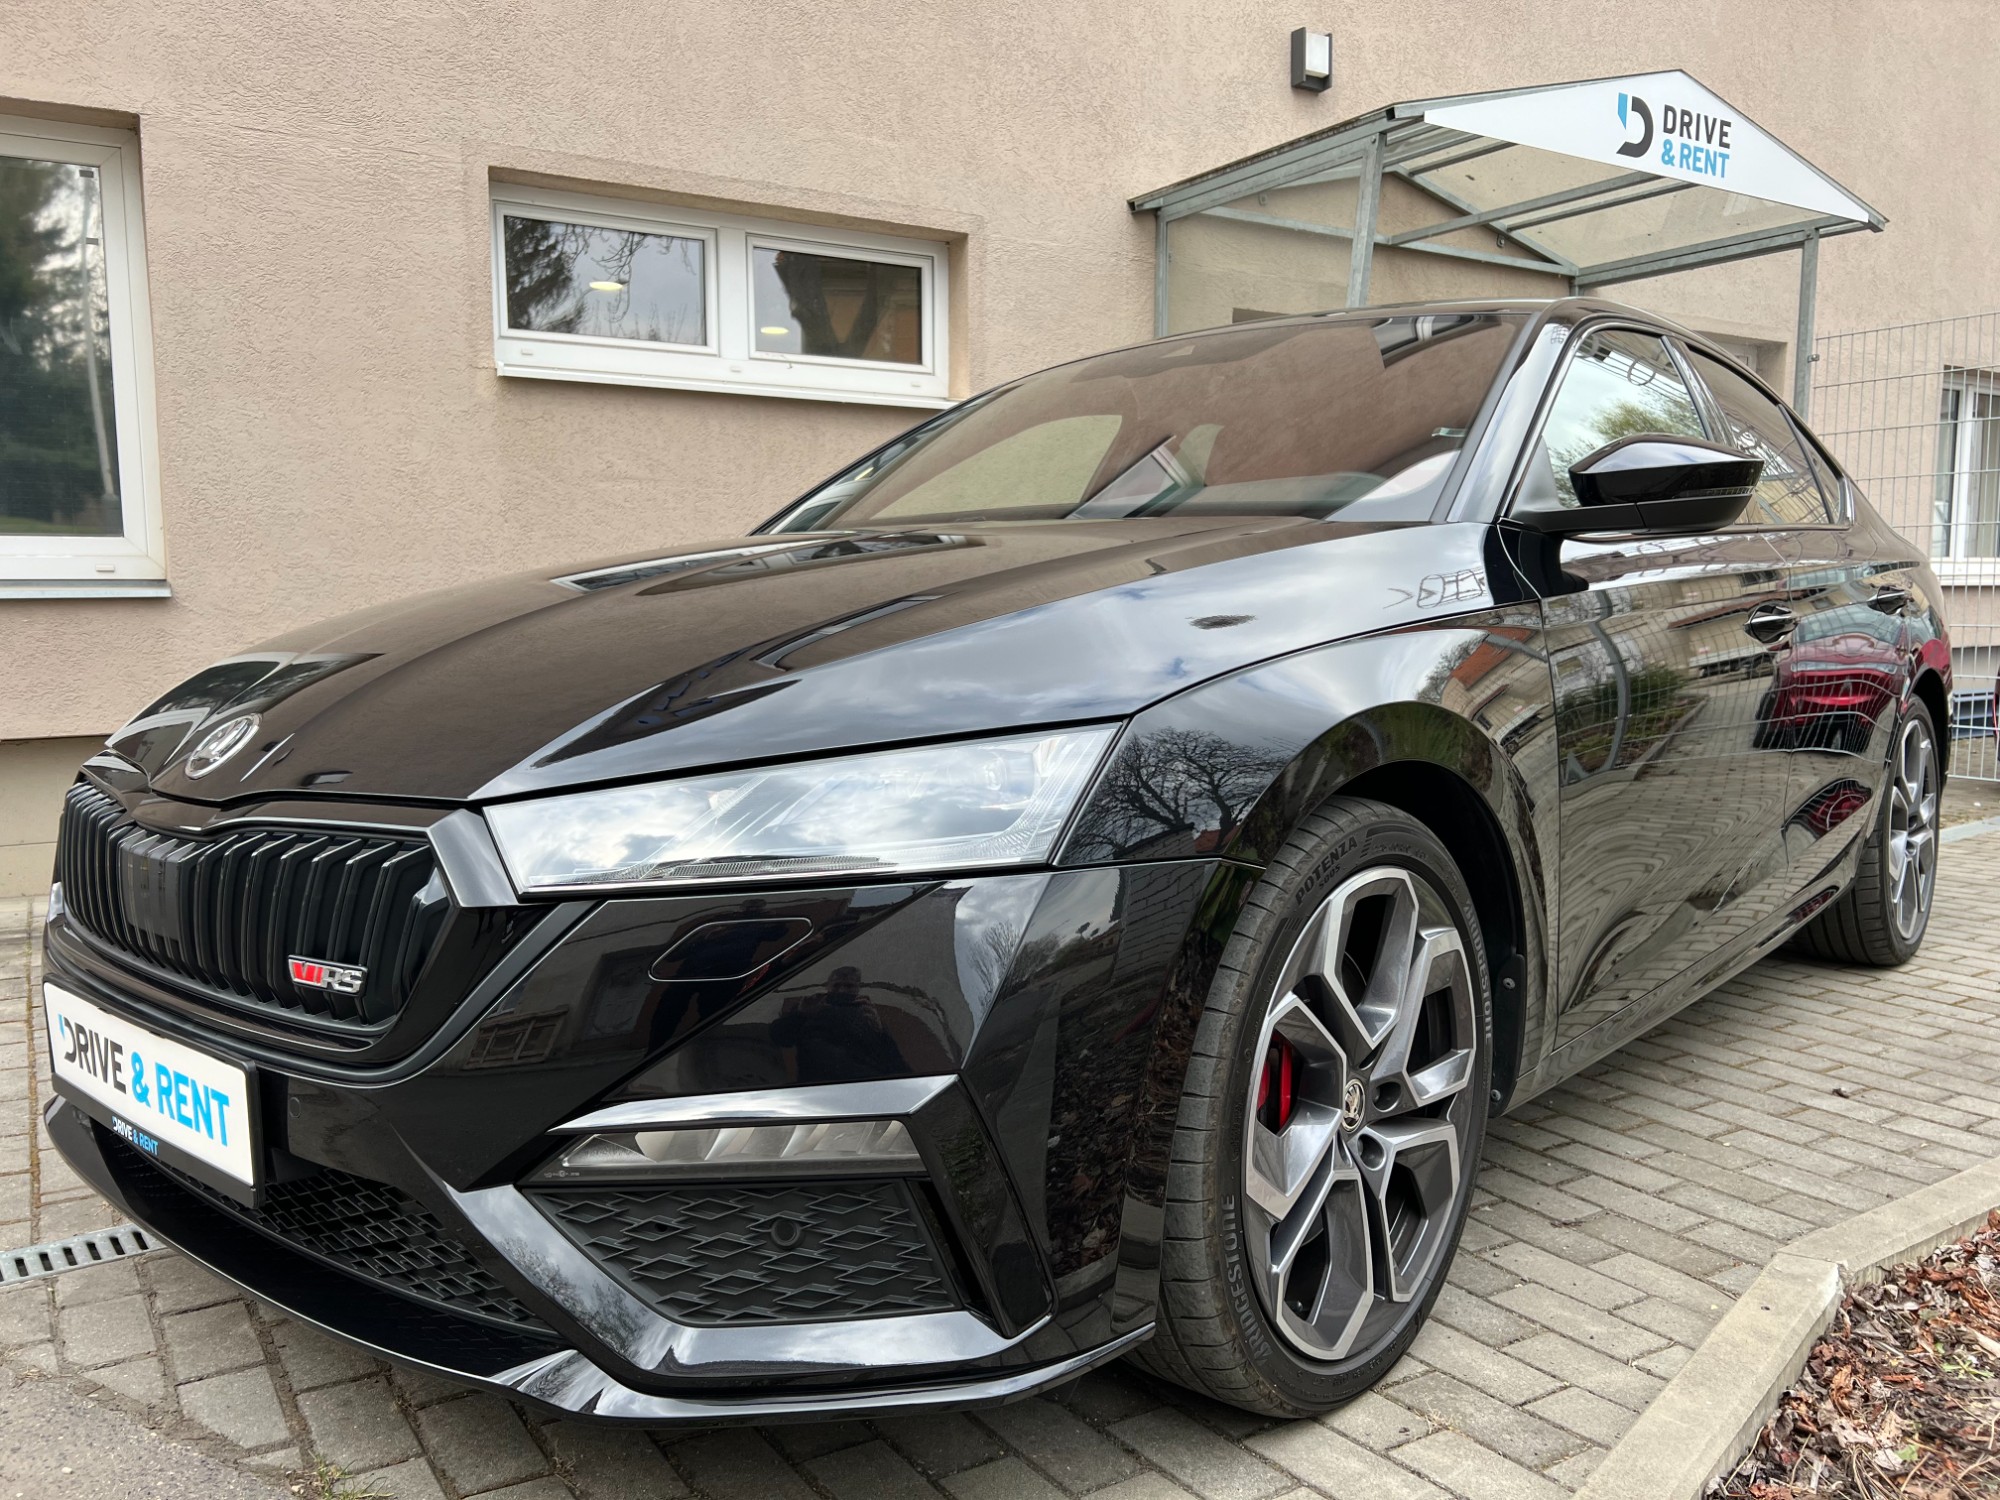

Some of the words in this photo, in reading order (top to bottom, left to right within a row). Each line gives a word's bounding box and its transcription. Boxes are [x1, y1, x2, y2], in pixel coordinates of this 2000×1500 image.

[1662, 104, 1732, 149] DRIVE
[1661, 138, 1676, 167] &
[1679, 142, 1730, 178] RENT
[1295, 836, 1358, 906] POTENZA
[58, 1013, 127, 1095] DRIVE
[130, 1051, 151, 1108] &
[154, 1061, 230, 1147] RENT
[112, 1115, 133, 1142] DRIVE
[133, 1128, 139, 1145] &
[139, 1132, 159, 1156] RENT
[1220, 1193, 1274, 1367] BRIDGESTONE
